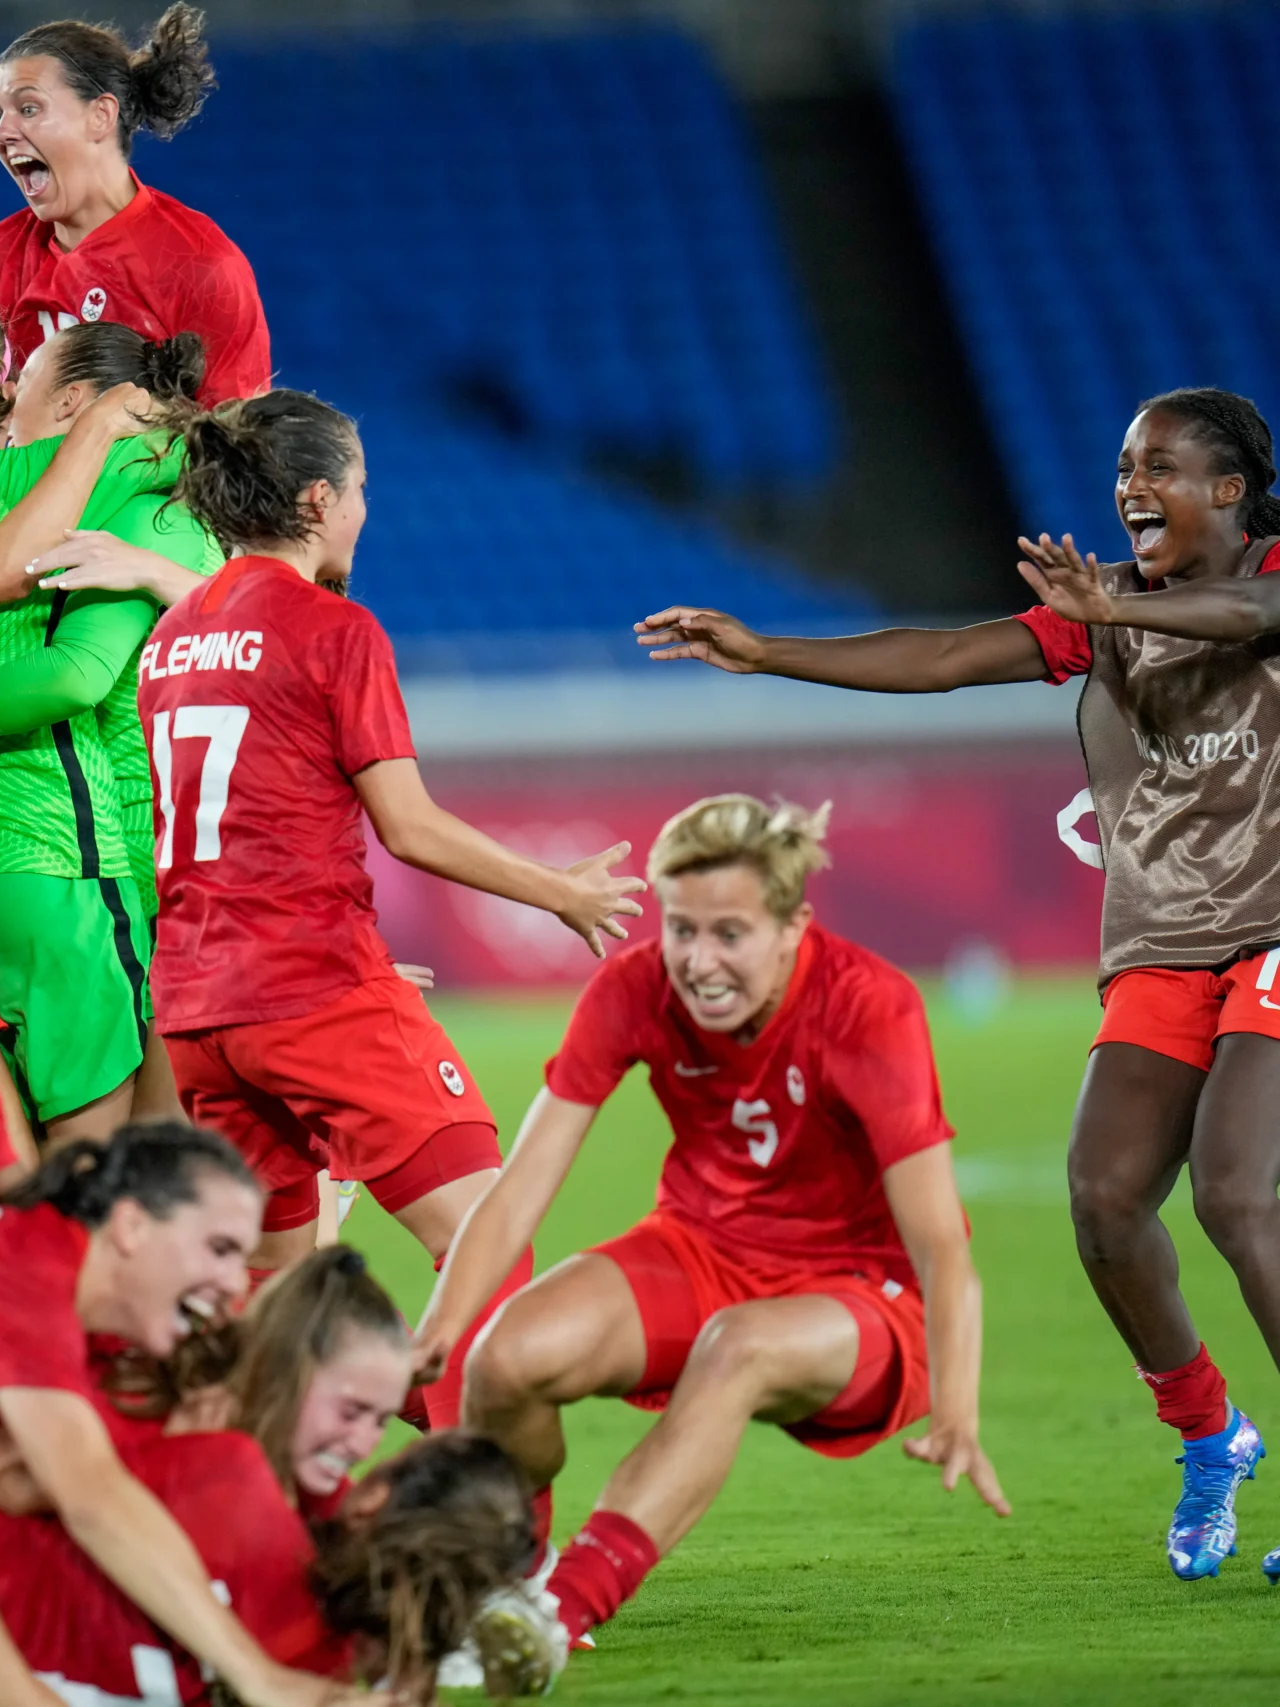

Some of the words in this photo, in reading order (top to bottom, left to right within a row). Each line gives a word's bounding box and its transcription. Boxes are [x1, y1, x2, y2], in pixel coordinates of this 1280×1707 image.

[138, 630, 263, 687] FLEMING
[1184, 729, 1259, 764] 2020
[153, 705, 251, 869] 17
[731, 1098, 779, 1168] 5
